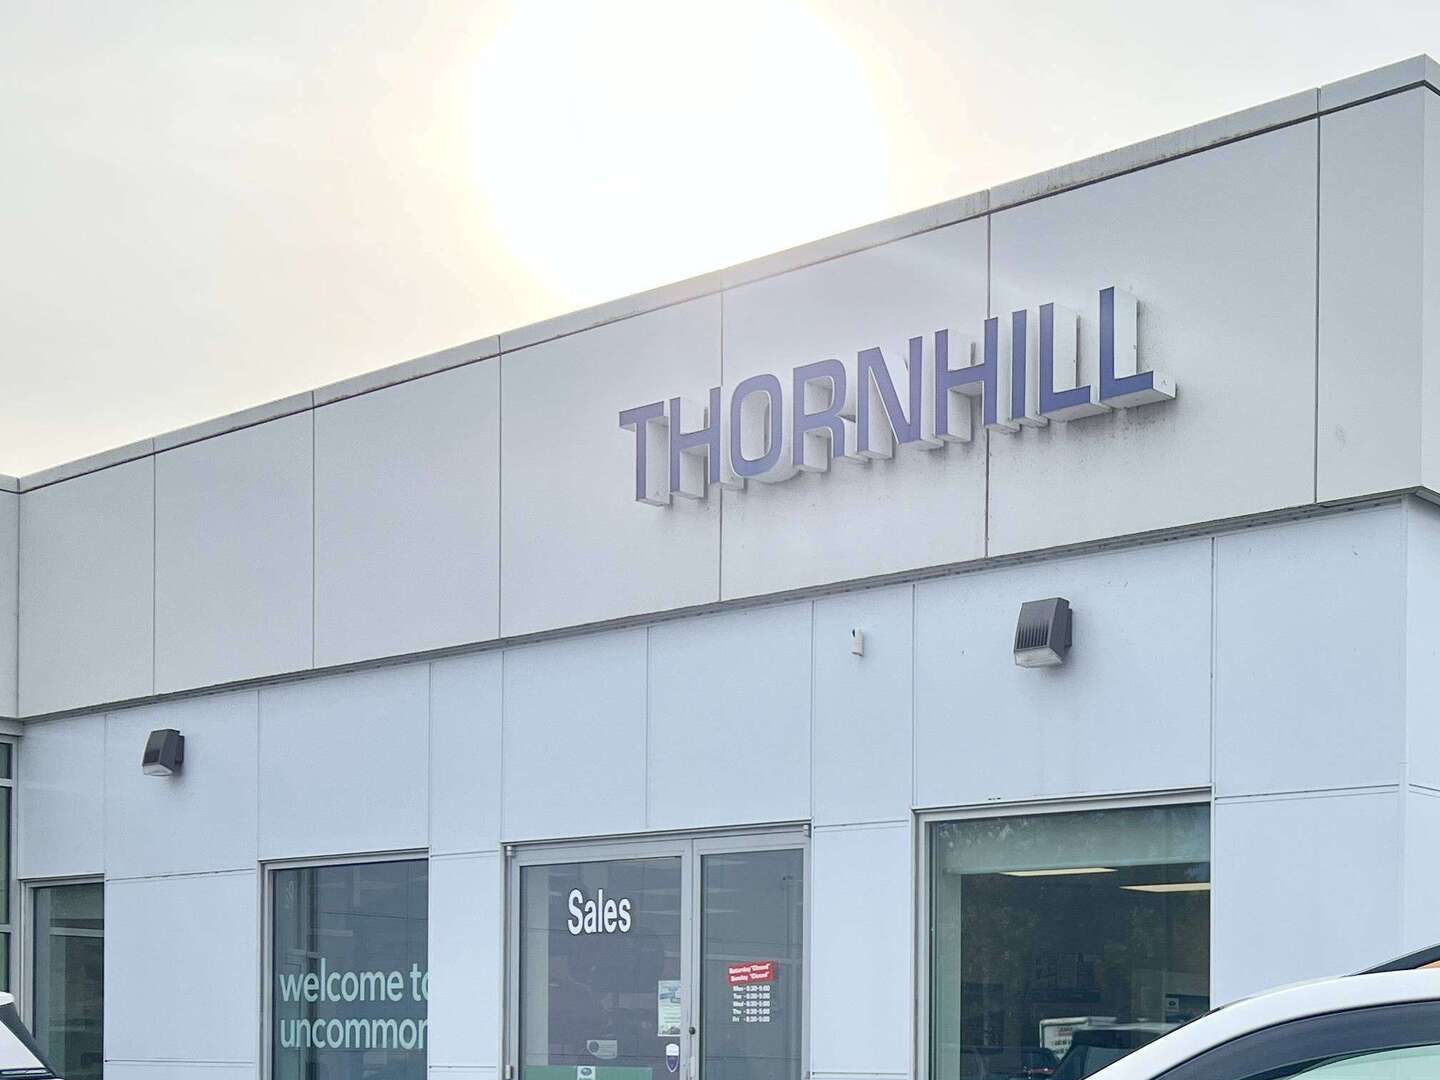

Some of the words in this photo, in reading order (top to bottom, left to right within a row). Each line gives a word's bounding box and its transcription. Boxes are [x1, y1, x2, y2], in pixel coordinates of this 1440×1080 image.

[619, 287, 1162, 502] THORNHILL
[567, 888, 632, 935] Sales
[279, 957, 404, 1002] welcome
